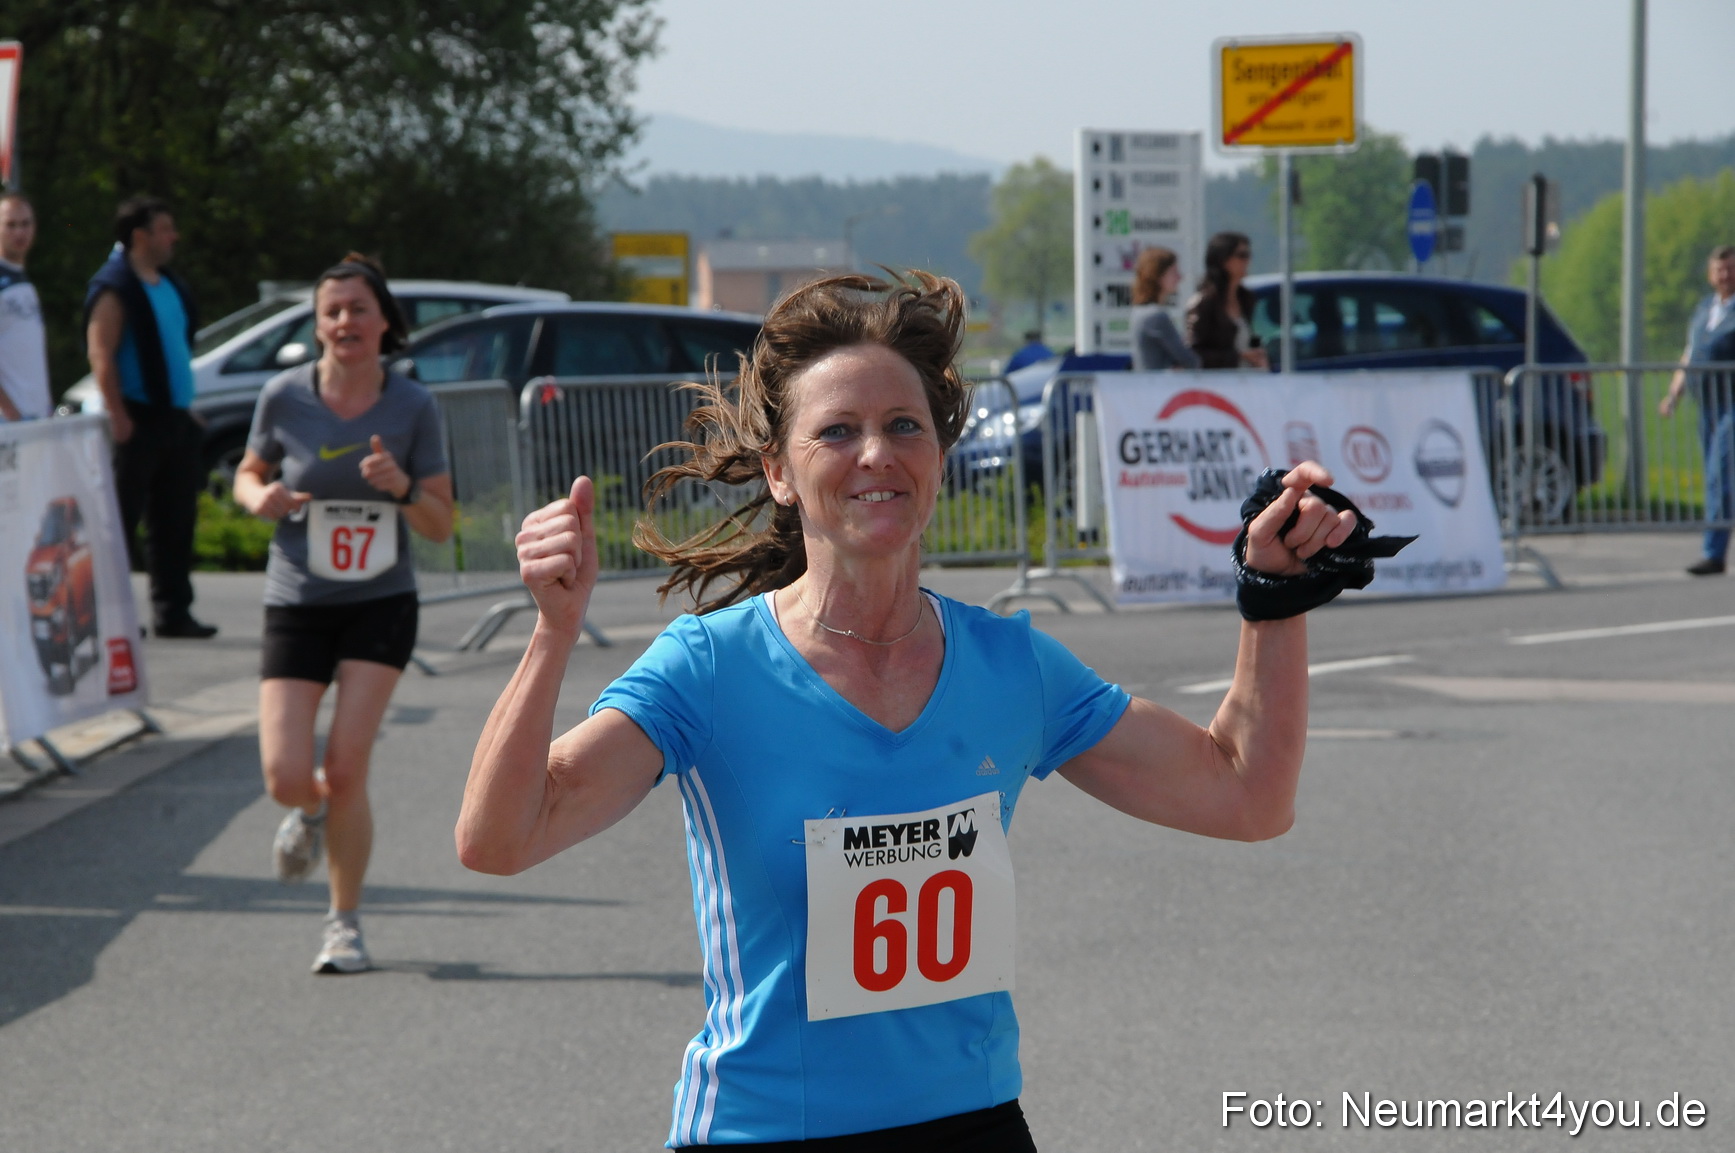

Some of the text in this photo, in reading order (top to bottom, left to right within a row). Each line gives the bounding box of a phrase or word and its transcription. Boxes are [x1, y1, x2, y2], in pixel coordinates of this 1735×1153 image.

[1119, 429, 1234, 465] GERHART
[331, 525, 376, 572] 67
[976, 768, 1001, 777] adidas
[843, 818, 942, 850] MEYER
[844, 843, 942, 868] WERBUNG
[853, 869, 973, 992] 60
